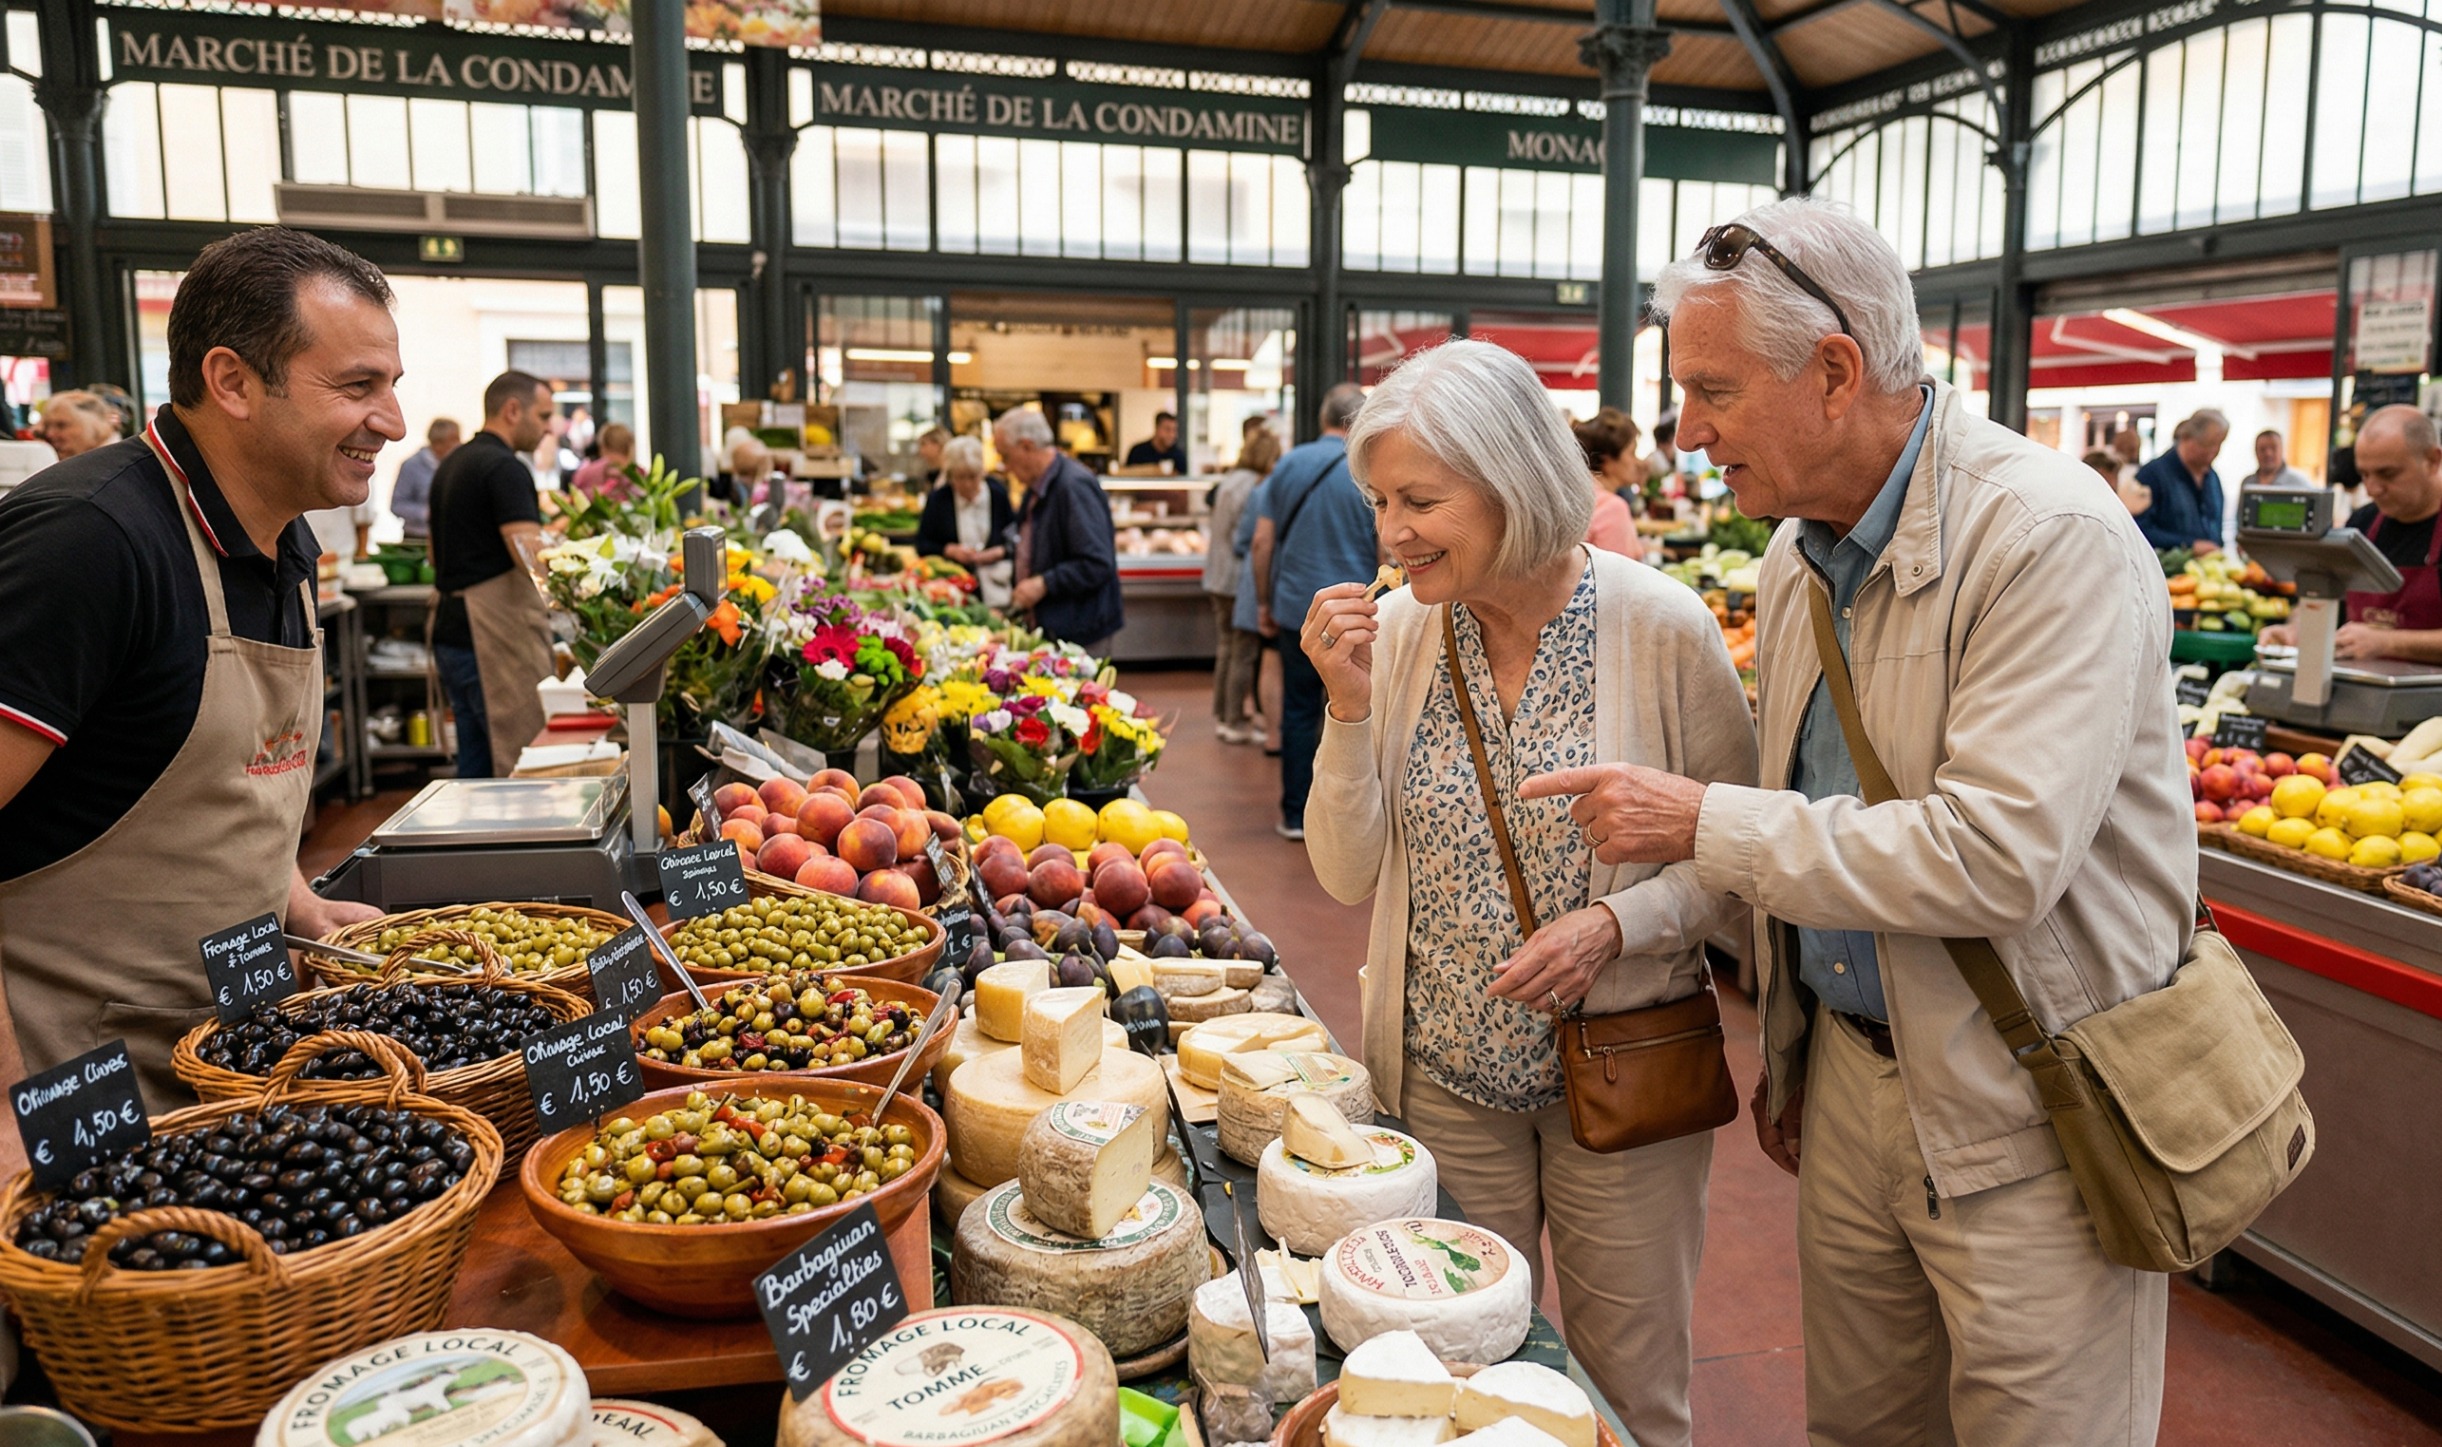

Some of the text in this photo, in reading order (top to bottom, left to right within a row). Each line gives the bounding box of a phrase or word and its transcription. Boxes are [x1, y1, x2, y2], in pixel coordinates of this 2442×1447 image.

[119, 31, 717, 105] MARCHÉ DE LA CONDAME
[819, 81, 1301, 146] MARCHÉ DE LA CONDAMINE
[1506, 129, 1607, 166] MONA
[694, 881, 727, 901] 1,50
[202, 917, 279, 960] Fromage Local
[243, 969, 274, 996] 1,50
[622, 977, 644, 1005] 1,50
[569, 1072, 611, 1105] 1,50
[759, 1219, 876, 1310] Barbagiuan
[786, 1249, 883, 1336] Specialties
[829, 1296, 878, 1354] 1,80
[290, 1345, 412, 1431] FROMAGE
[425, 1337, 522, 1357] LOCAL
[838, 1317, 1032, 1398] FROMAGE LOCAL
[886, 1363, 991, 1411] TOMME
